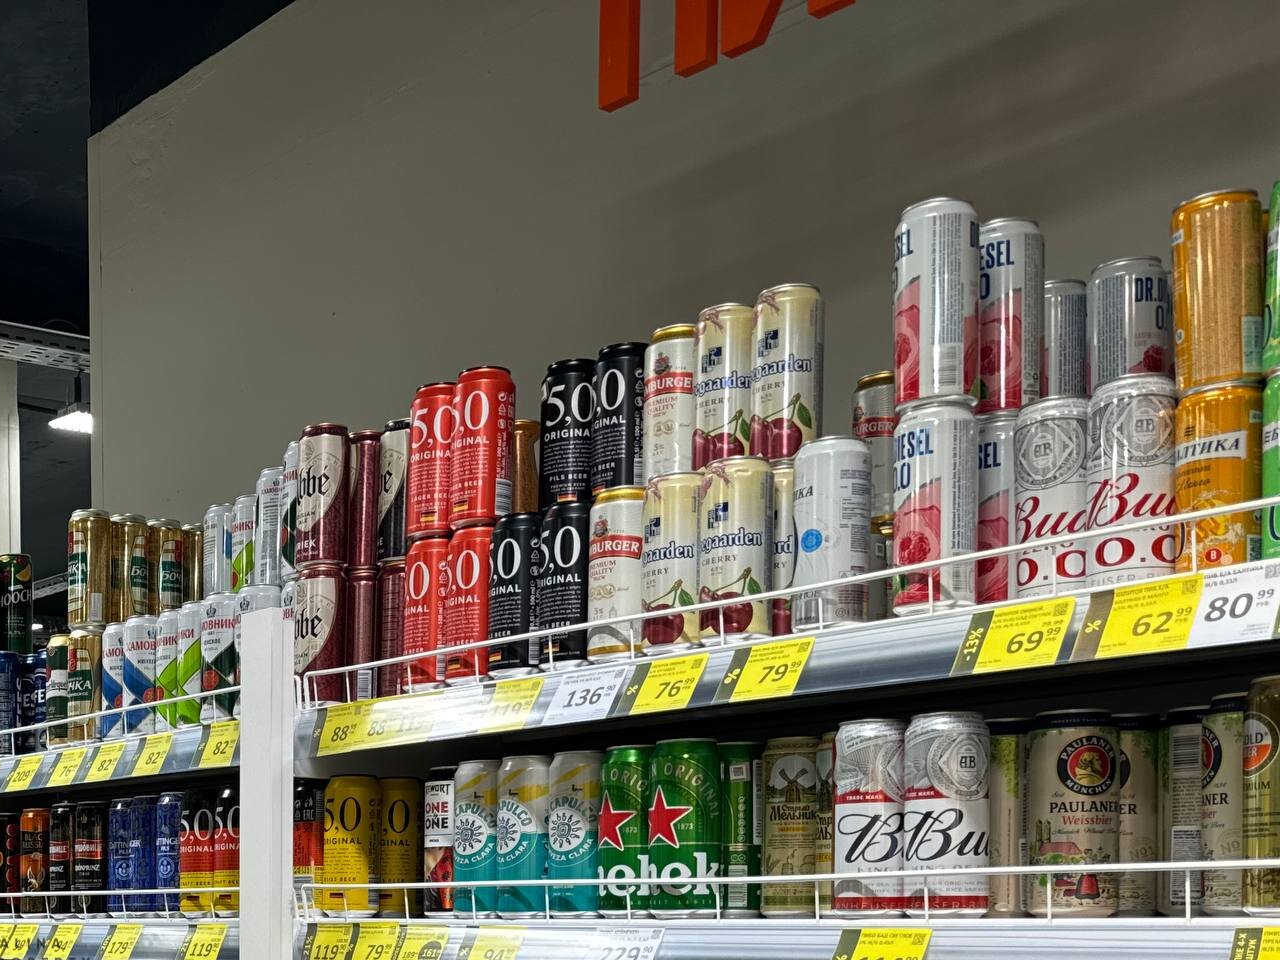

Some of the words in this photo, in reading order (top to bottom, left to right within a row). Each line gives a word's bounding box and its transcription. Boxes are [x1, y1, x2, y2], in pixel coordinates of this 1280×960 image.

[593, 415, 626, 430] GINAL
[1204, 593, 1253, 623] 80
[1258, 589, 1275, 599] 99
[1132, 611, 1174, 637] 62
[1176, 607, 1192, 617] 99
[964, 628, 983, 661] -13%
[1006, 630, 1044, 654] 69
[1047, 626, 1061, 636] 99
[758, 663, 788, 685] 79
[790, 660, 802, 669] 99
[563, 687, 603, 710] 136
[654, 680, 683, 699] 76
[684, 677, 695, 685] 99
[331, 725, 349, 742] 88
[425, 802, 449, 815] ONE
[425, 816, 449, 829] ONE
[314, 944, 339, 960] 119
[365, 944, 385, 960] 79
